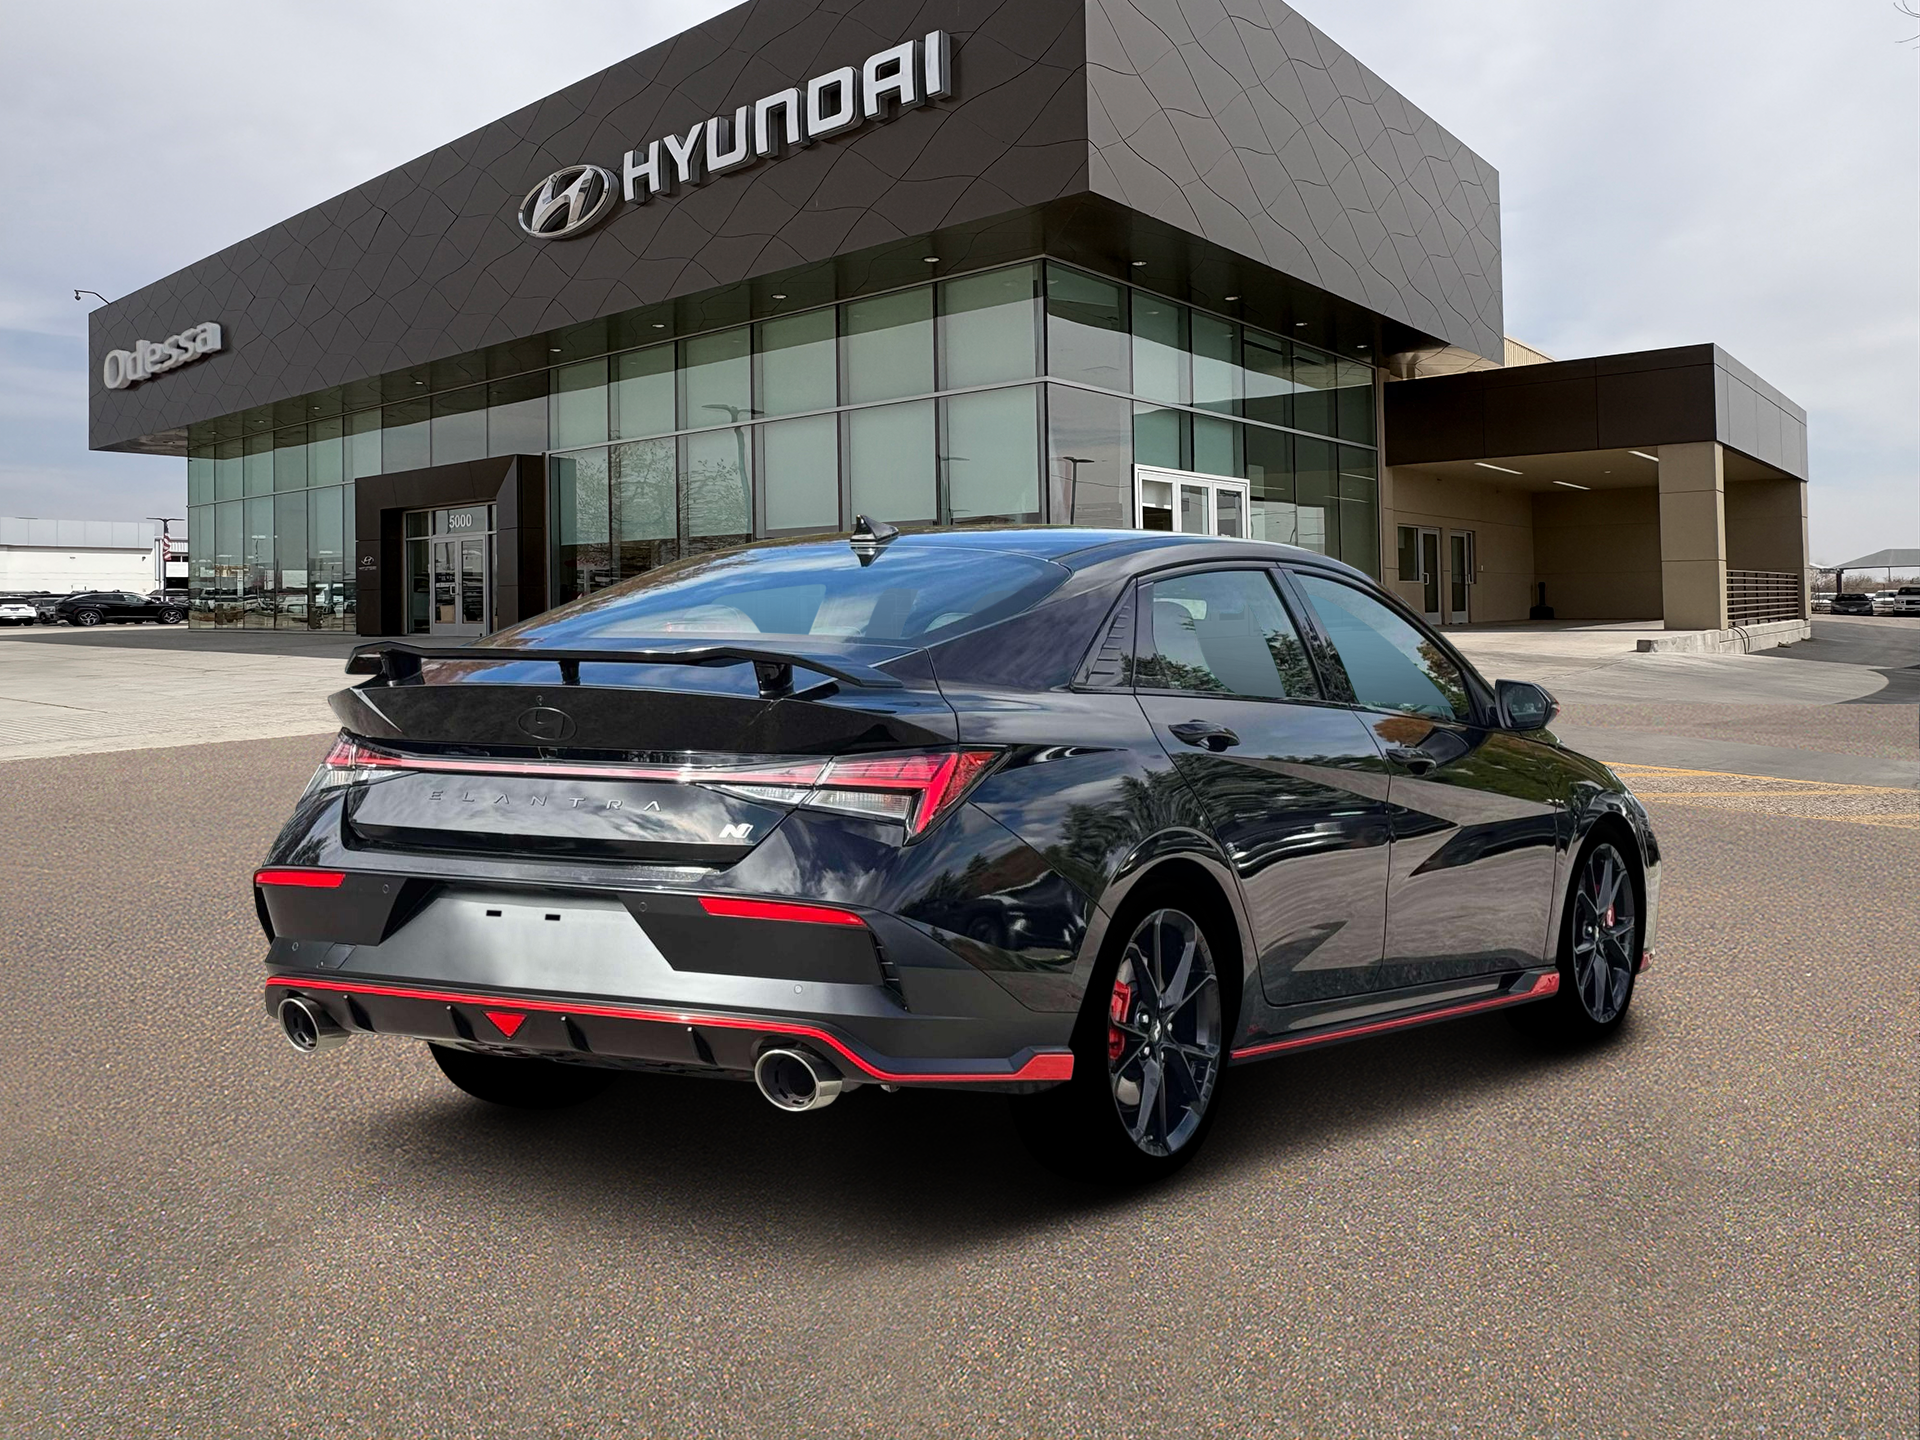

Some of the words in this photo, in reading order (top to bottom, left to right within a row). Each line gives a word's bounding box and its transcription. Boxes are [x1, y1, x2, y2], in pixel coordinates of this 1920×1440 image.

[622, 29, 950, 202] HYUNDAI
[104, 321, 222, 390] Odessa
[449, 513, 472, 528] 5000
[429, 789, 662, 812] ELANTRA
